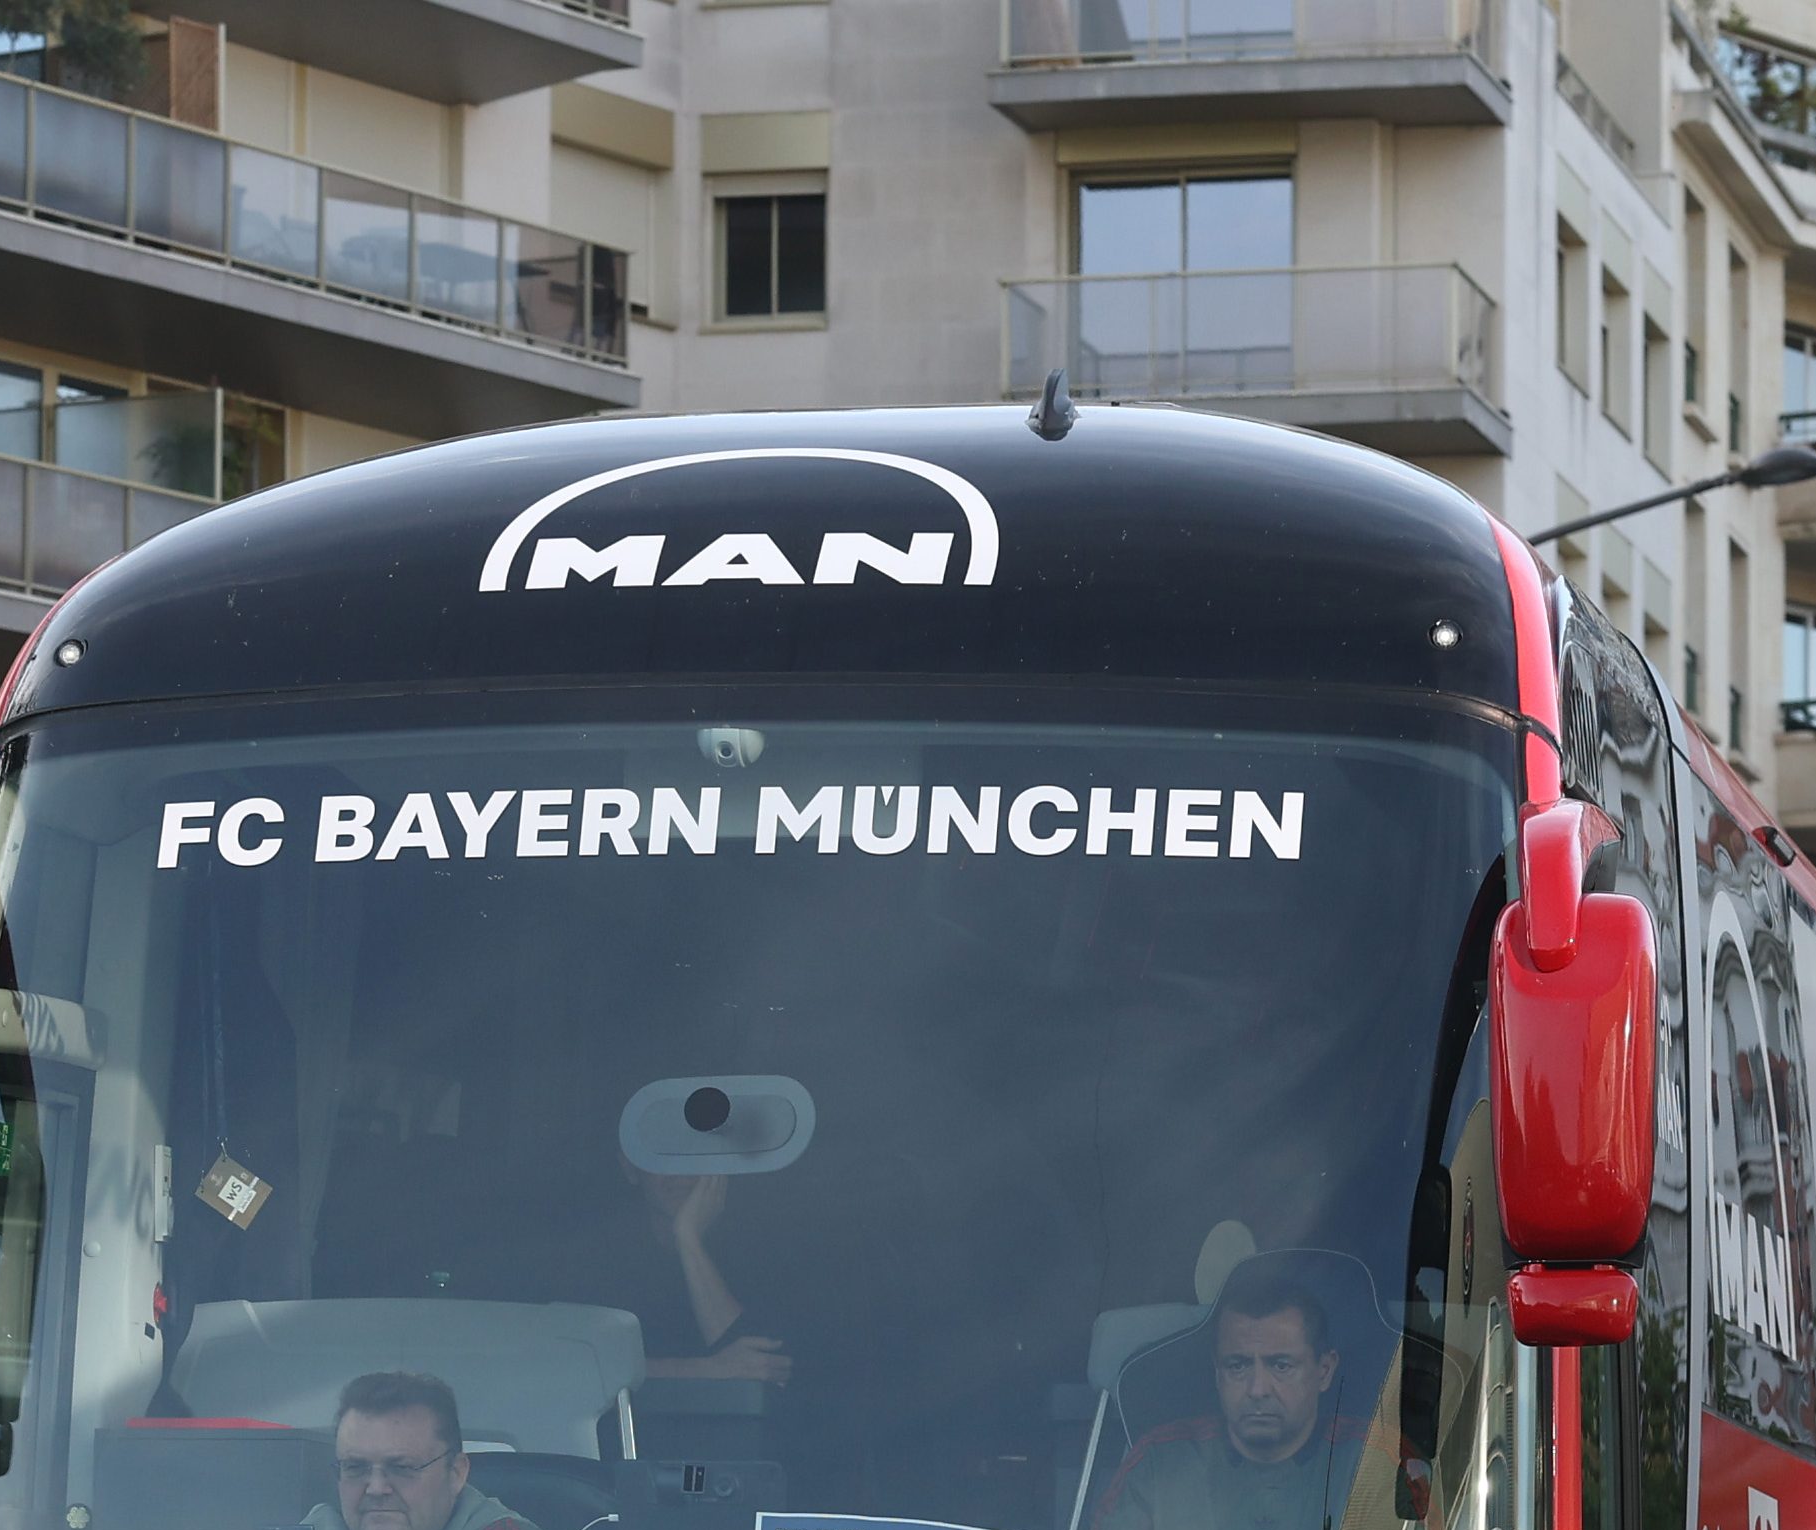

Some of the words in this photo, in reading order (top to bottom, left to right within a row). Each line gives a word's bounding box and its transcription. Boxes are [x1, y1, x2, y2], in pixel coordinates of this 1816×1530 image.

[526, 531, 954, 588] MAN
[156, 798, 286, 869] FC
[314, 787, 721, 862] BAYERN
[753, 782, 1305, 859] MÜNCHEN
[1716, 1191, 1790, 1357] MAN
